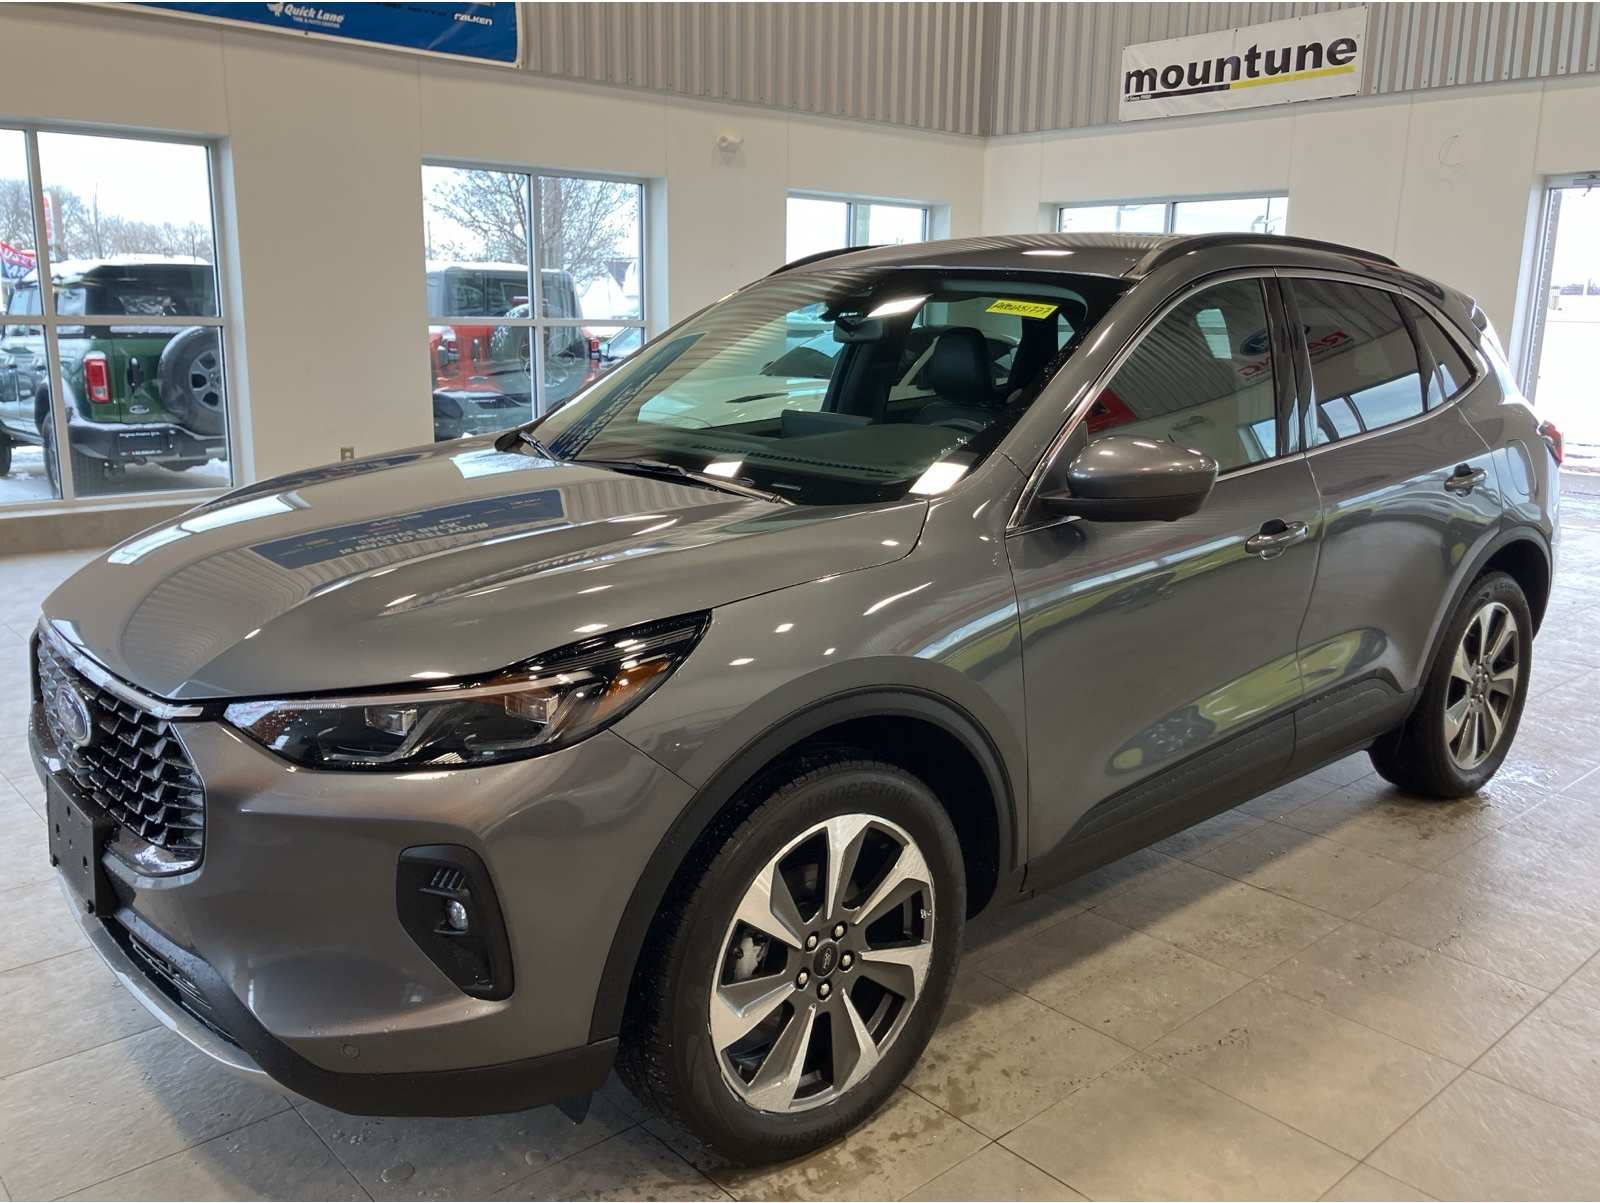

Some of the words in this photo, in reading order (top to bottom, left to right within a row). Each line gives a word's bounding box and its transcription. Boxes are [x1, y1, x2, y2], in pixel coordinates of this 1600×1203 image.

[284, 4, 316, 17] Quick
[317, 9, 345, 23] Lane
[453, 12, 493, 26] FALKEN
[1124, 37, 1357, 94] mountune
